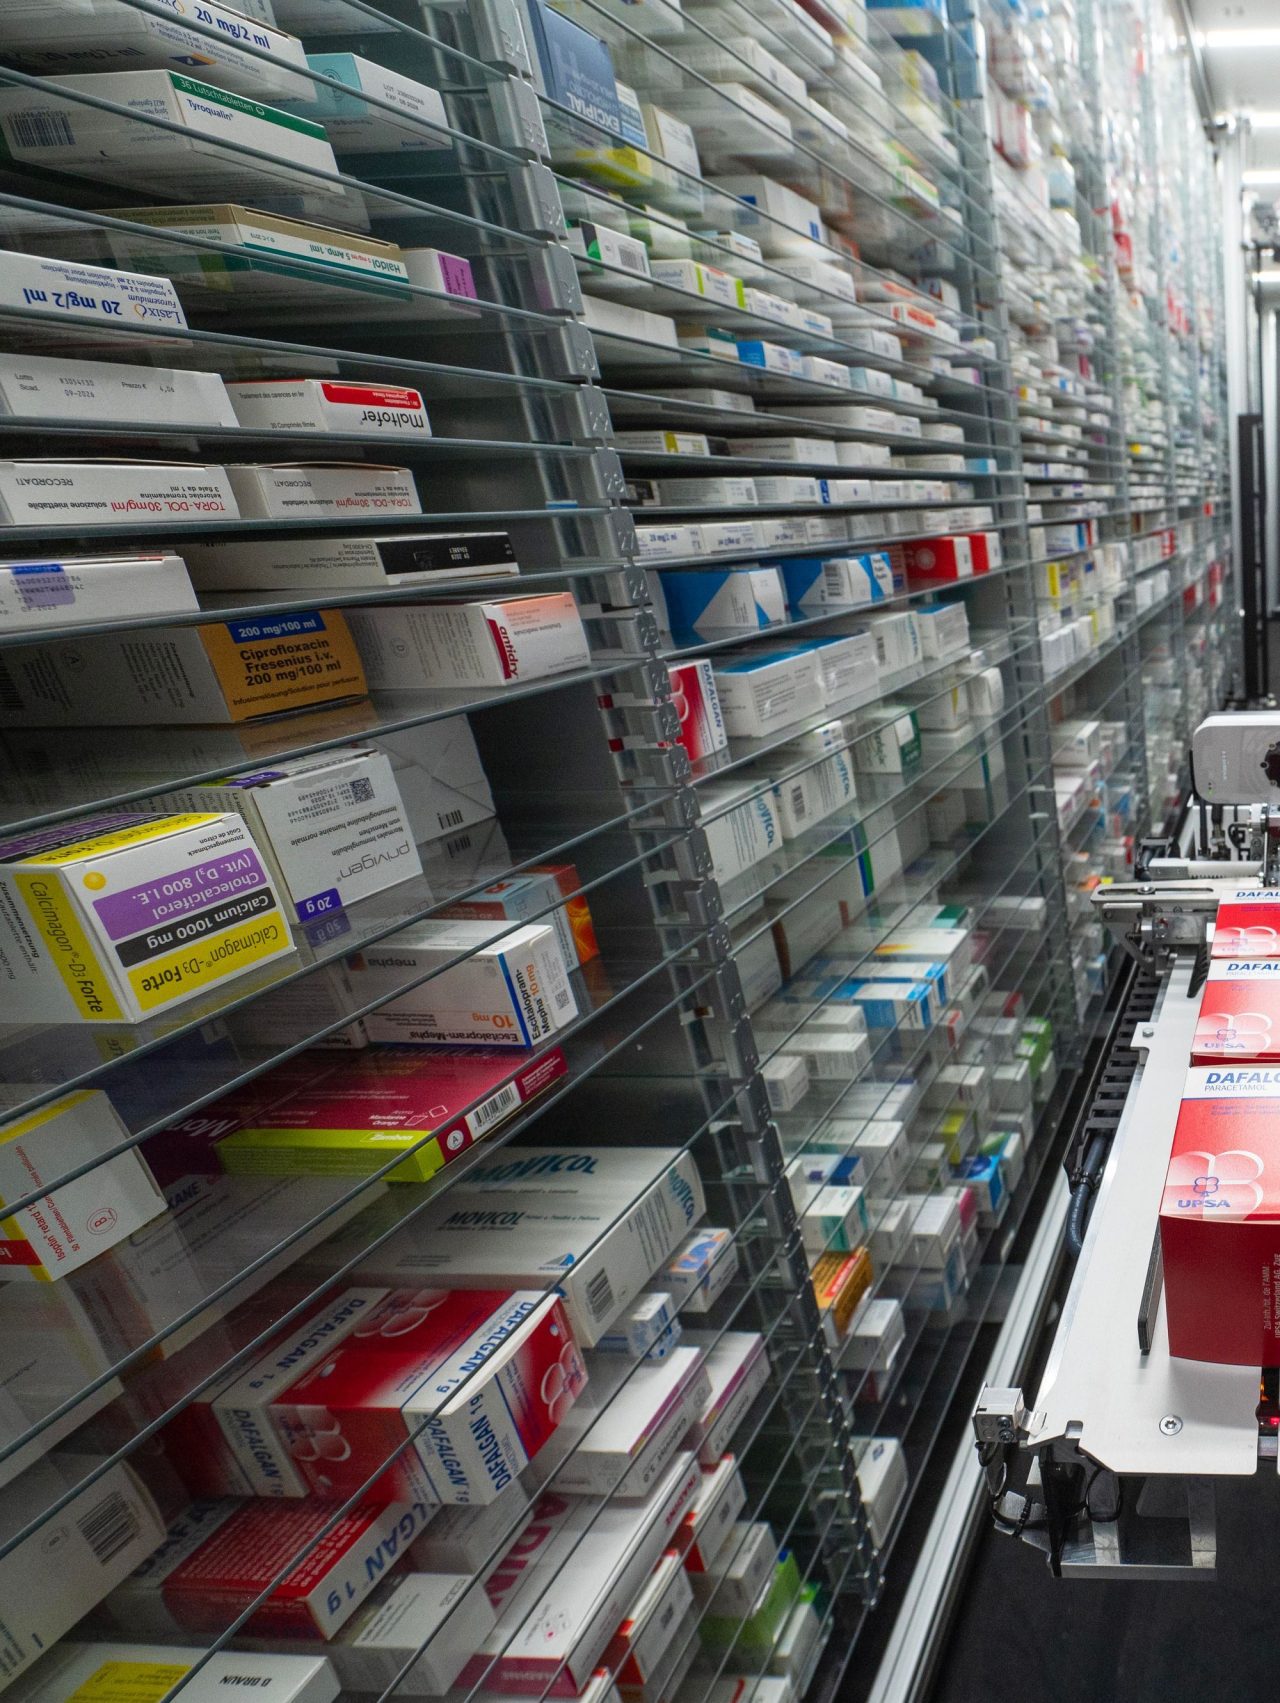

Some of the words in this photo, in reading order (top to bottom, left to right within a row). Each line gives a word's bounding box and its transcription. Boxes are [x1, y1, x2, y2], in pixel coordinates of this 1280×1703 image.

[193, 6, 213, 25] 20
[216, 18, 251, 40] mg/2
[254, 33, 271, 49] ml
[180, 79, 192, 89] 36
[193, 82, 254, 112] Lutschtabletten
[566, 91, 619, 132] EXCIPIAL
[372, 259, 400, 274] Haldol
[23, 288, 47, 304] ml
[52, 291, 97, 309] mg/2
[128, 294, 177, 308] Furosemidum
[102, 300, 122, 315] 20
[150, 305, 182, 324] Lasix
[16, 478, 74, 486] RECORDATI
[28, 502, 69, 510] iniettabile
[70, 502, 107, 510] soluzione
[111, 500, 162, 512] 30mg/ml
[167, 501, 226, 512] TORA-DOL
[336, 499, 369, 509] 30mg/ml
[371, 499, 412, 508] TORA-DOL
[239, 627, 260, 638] 200
[263, 622, 301, 636] mg/100
[304, 619, 316, 628] ml
[640, 624, 660, 647] 25
[240, 639, 329, 662] Ciprofloxacin
[500, 626, 519, 678] antidry
[246, 655, 312, 674] Fresenius
[315, 651, 333, 661] i.v.
[245, 674, 271, 687] 200
[276, 665, 322, 681] mg/100
[326, 661, 341, 671] ml
[651, 672, 669, 693] 24
[703, 664, 722, 728] DAFALGAN
[672, 758, 690, 780] 22
[347, 806, 397, 828] Immunoglobuline
[389, 817, 401, 827] vom
[227, 827, 241, 837] Goût
[318, 821, 346, 838] humaine
[359, 821, 388, 836] Menschen
[376, 826, 404, 841] Normales
[188, 835, 245, 857] Zitronengeschmack
[199, 834, 216, 844] citron
[291, 831, 317, 846] normale
[332, 835, 376, 857] Immunglobulin
[221, 854, 251, 871] (Vit.
[162, 879, 193, 895] 800
[132, 889, 161, 905] I.E.
[153, 872, 260, 920] Cholecalciferol
[316, 896, 332, 909] 20
[215, 895, 269, 922] Calcium
[306, 901, 315, 913] g
[176, 917, 213, 938] 1000
[146, 932, 173, 949] mg
[367, 957, 416, 968] mepha
[141, 964, 183, 992] Forte
[526, 964, 536, 980] mg
[77, 980, 103, 1014] Forte
[529, 981, 539, 996] 10
[516, 969, 541, 1040] Escitalopram-
[472, 1012, 490, 1022] mg
[492, 1013, 514, 1028] 10
[532, 1000, 549, 1034] Mepha
[1204, 1084, 1268, 1092] PARACETAMOL
[1177, 1199, 1231, 1208] UPSA
[31, 1208, 49, 1234] retard
[445, 1211, 526, 1225] MOVICOL
[277, 1299, 366, 1371] DAFALGAN
[459, 1301, 535, 1373] DAFALGAN
[250, 1380, 264, 1390] g
[435, 1385, 450, 1394] g
[233, 1409, 282, 1480] DAFALGAN
[427, 1417, 469, 1485] DAFALGAN
[471, 1420, 513, 1491] DAFALGAN
[344, 1581, 357, 1597] 1
[327, 1591, 342, 1615] g
[220, 1675, 260, 1686] BRAUN
